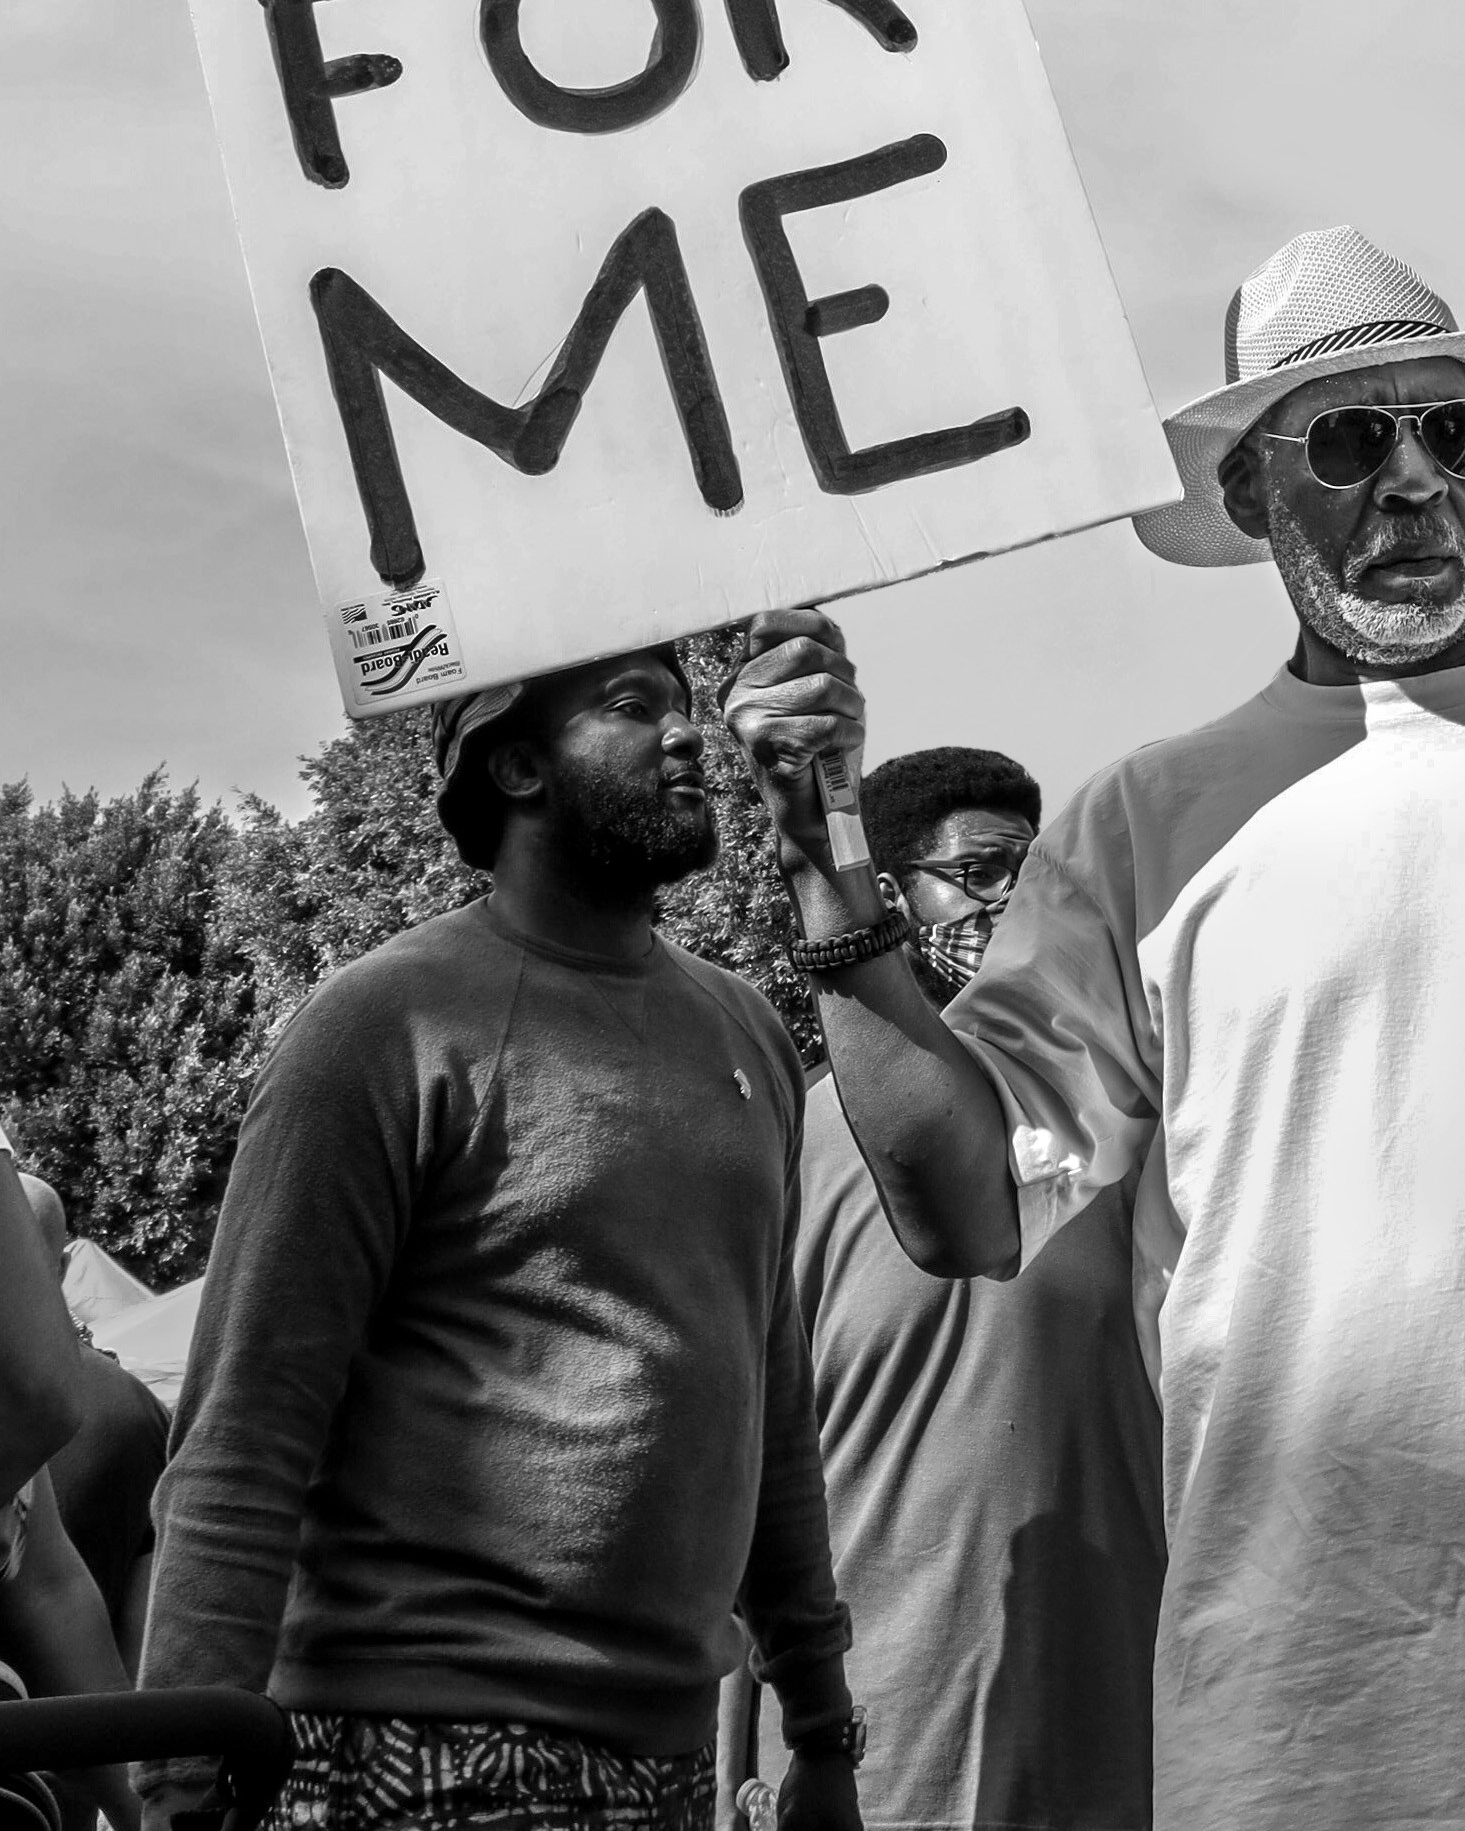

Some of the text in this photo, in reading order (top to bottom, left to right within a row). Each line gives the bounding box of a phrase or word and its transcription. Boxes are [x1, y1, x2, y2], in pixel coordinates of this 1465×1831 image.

[310, 132, 1032, 588] ME
[416, 668, 462, 684] Foam Board
